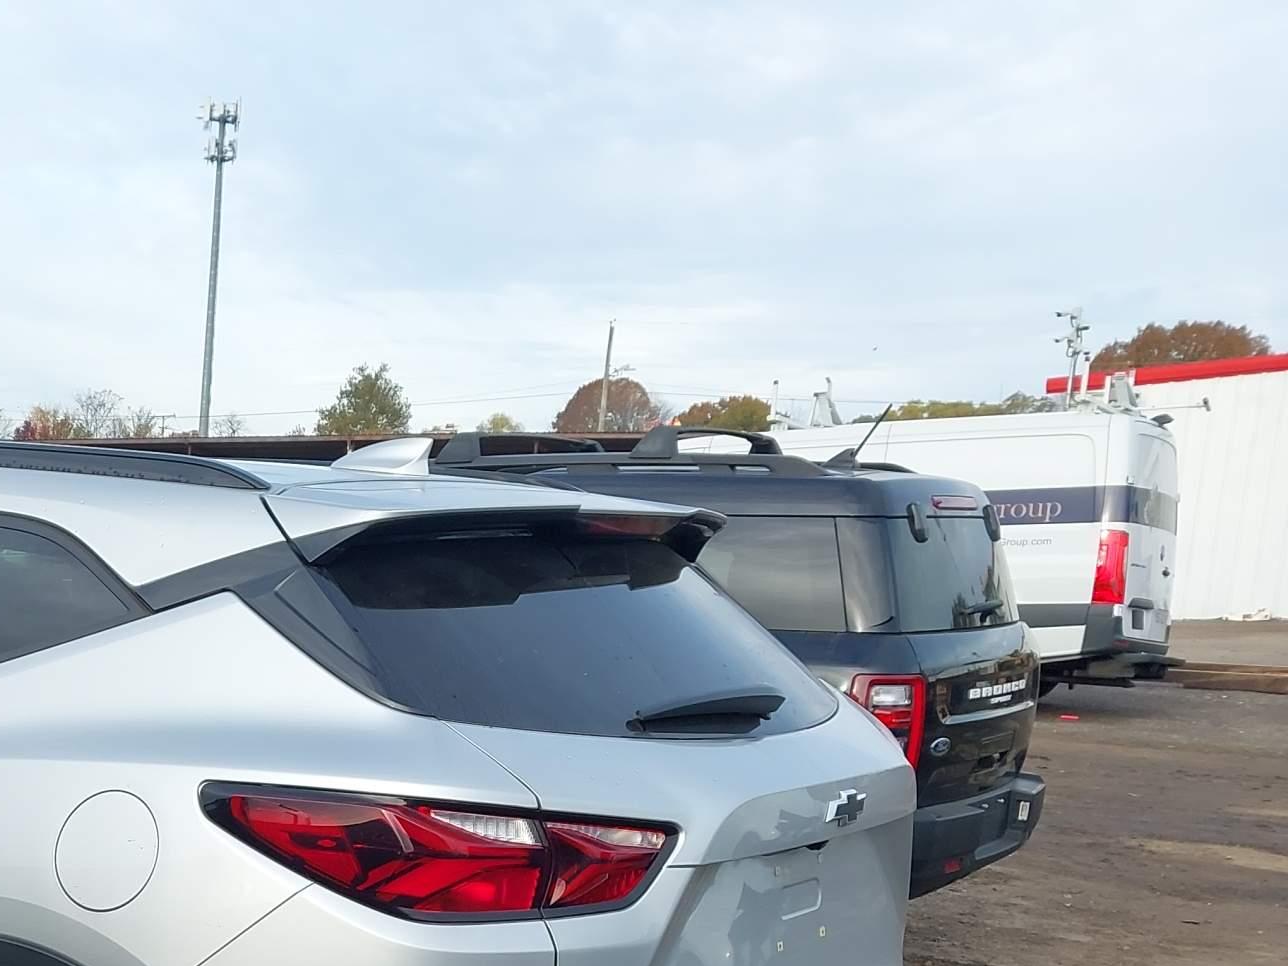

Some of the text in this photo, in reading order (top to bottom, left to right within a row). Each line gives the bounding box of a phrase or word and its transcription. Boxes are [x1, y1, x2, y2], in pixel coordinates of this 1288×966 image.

[994, 502, 1062, 522] roup
[1000, 537, 1052, 548] Group.com
[969, 680, 1027, 699] BRONCO
